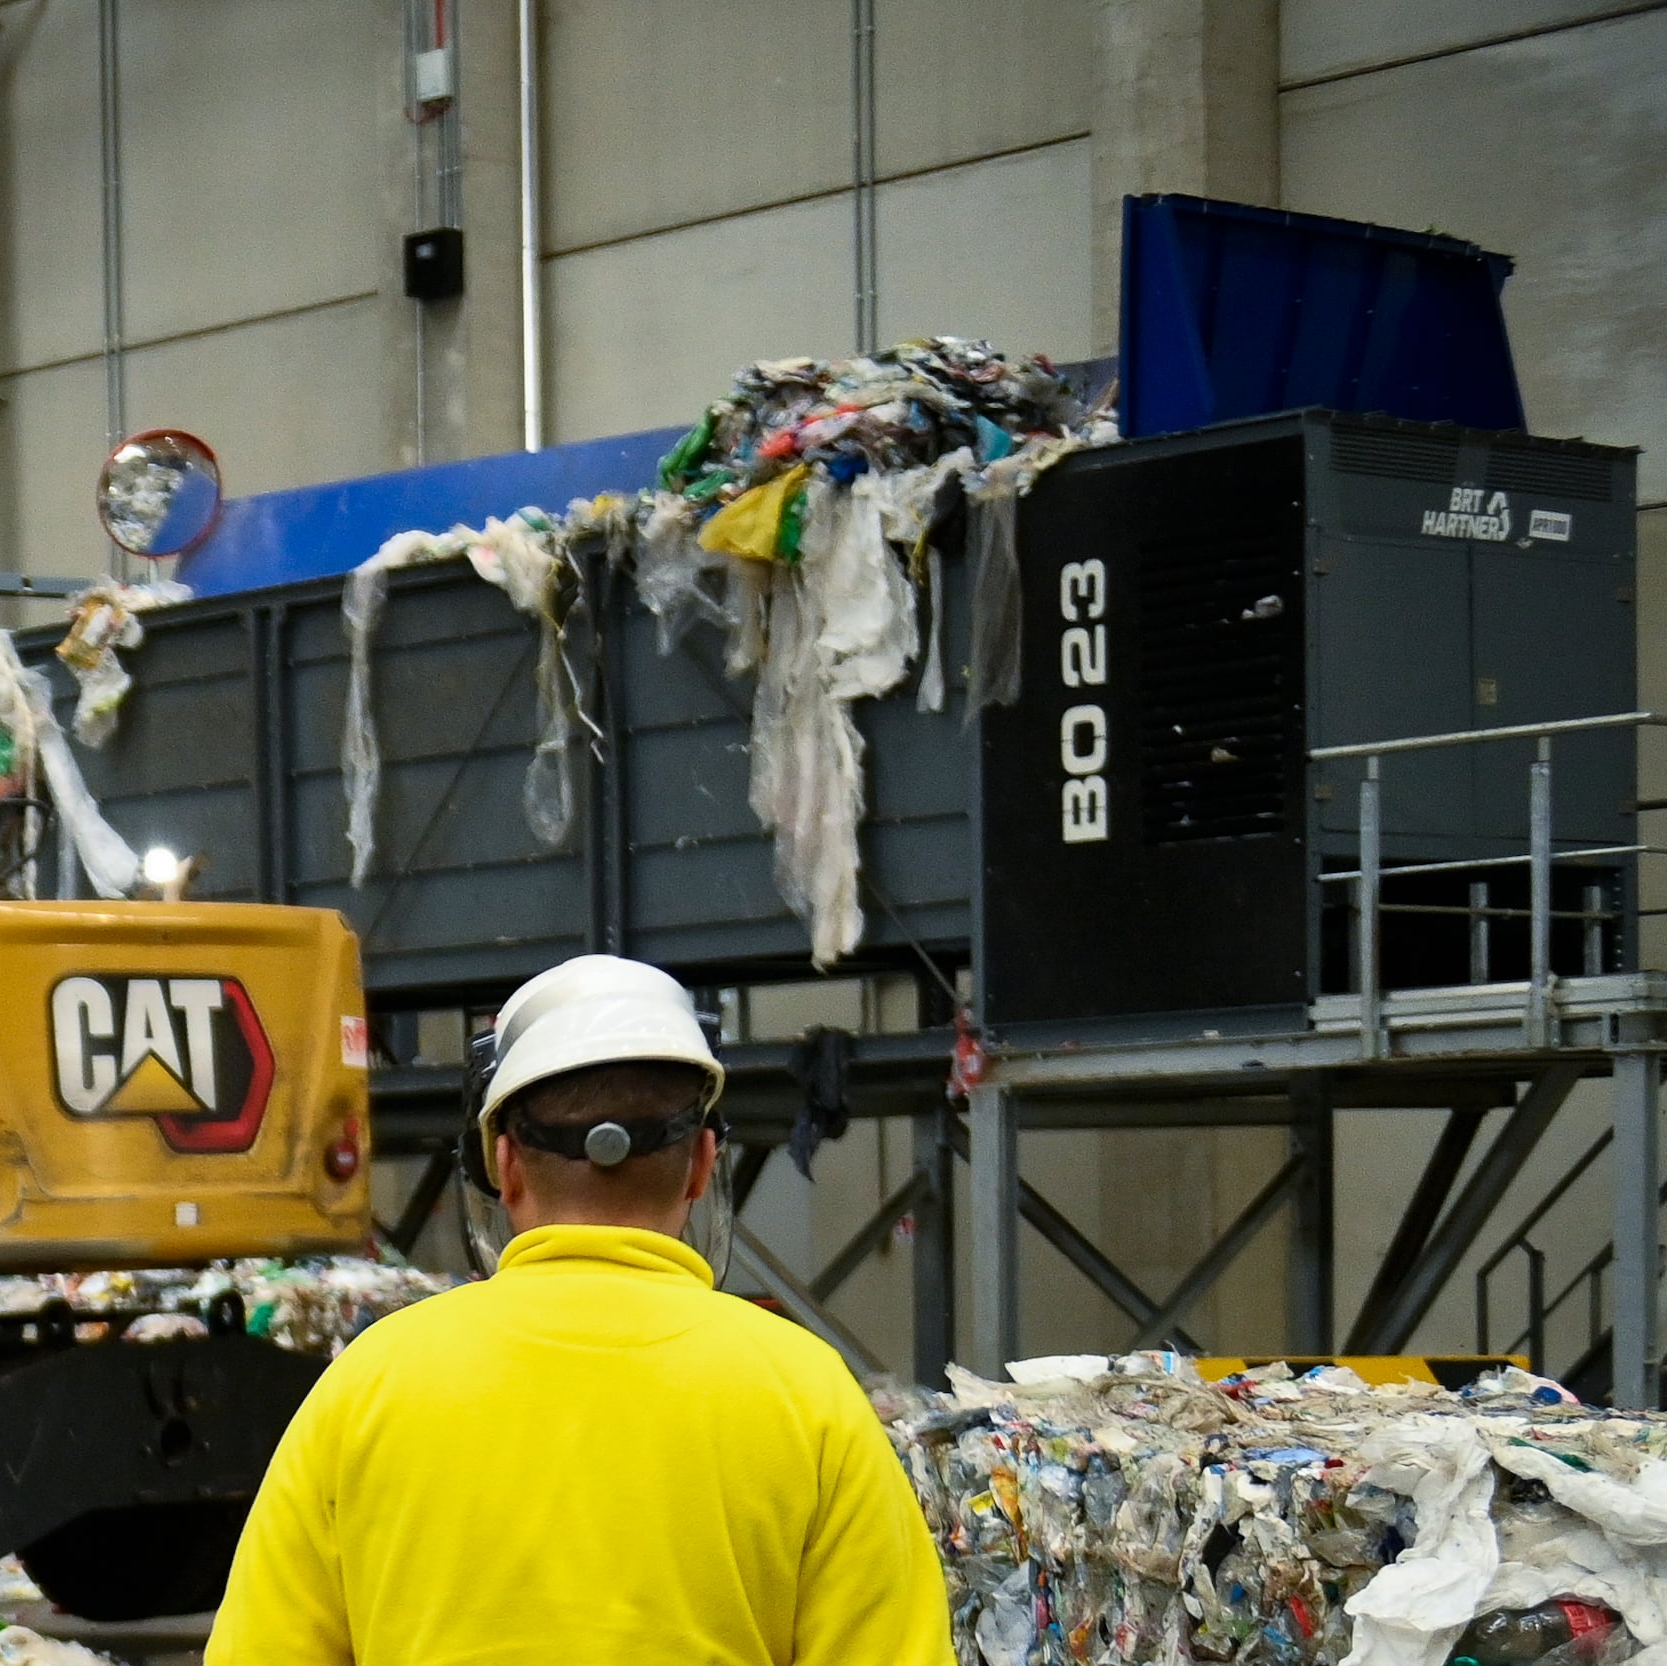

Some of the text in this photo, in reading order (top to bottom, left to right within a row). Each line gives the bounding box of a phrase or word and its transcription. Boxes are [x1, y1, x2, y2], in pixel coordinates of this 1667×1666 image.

[1061, 557, 1110, 845] BO 23
[51, 976, 224, 1114] CAT
